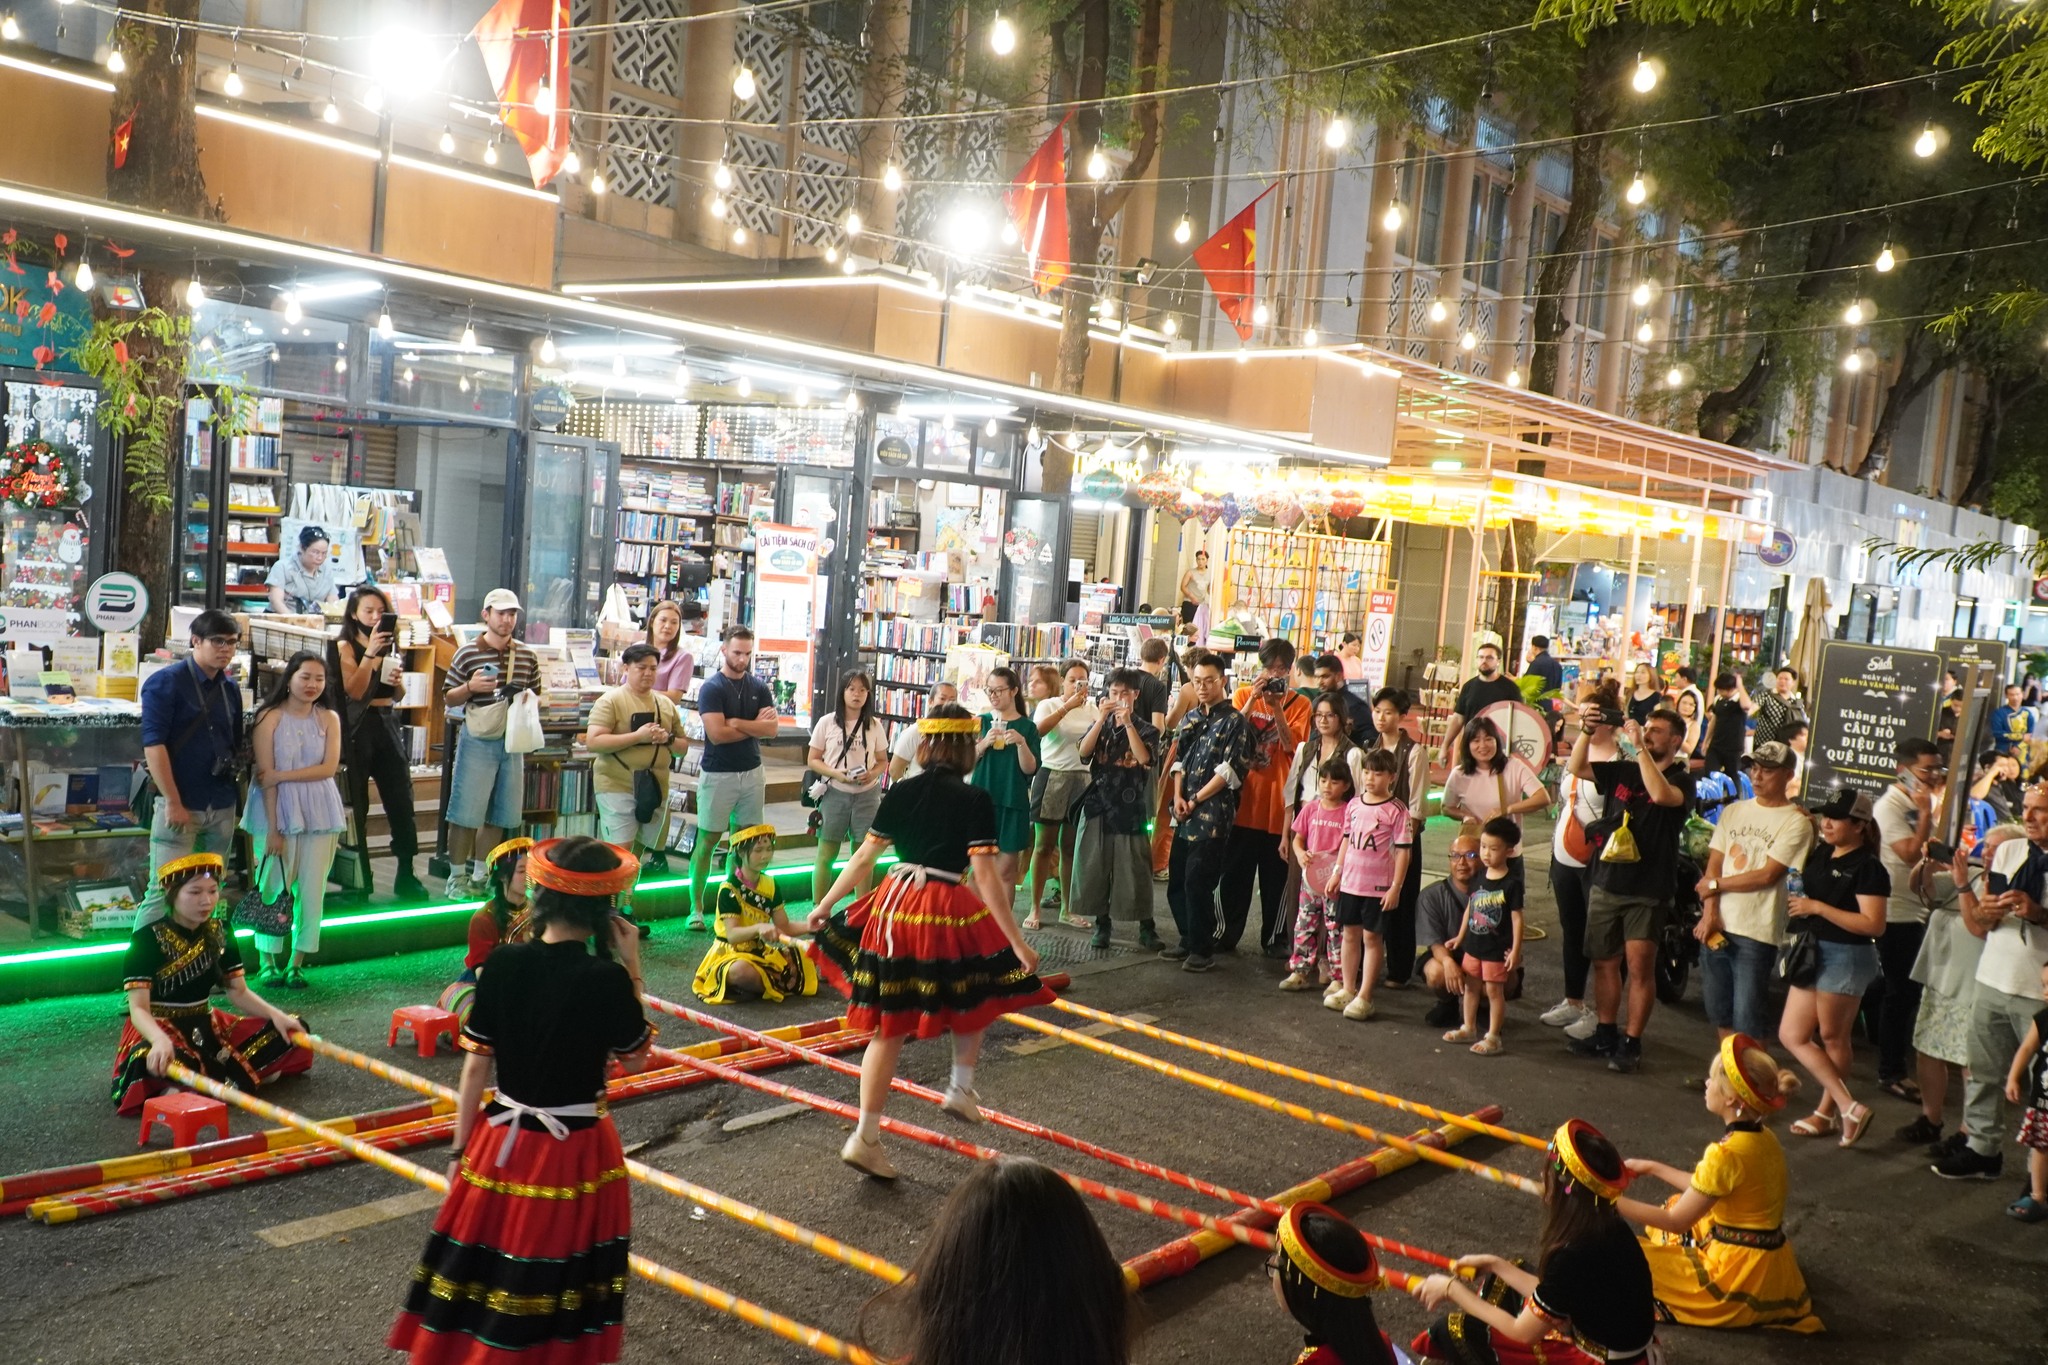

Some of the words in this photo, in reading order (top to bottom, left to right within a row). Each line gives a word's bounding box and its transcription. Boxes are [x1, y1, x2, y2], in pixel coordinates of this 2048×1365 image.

[9, 619, 65, 630] PHANBOOK
[1132, 615, 1148, 625] English
[1148, 616, 1171, 625] Bookstore
[1866, 654, 1893, 672] Sách
[1839, 676, 1857, 686] SÁCH
[1859, 679, 1869, 688] VÀ
[1869, 680, 1884, 690] VĂN
[1862, 673, 1880, 683] NGÀY
[1882, 674, 1896, 685] HỘI
[1840, 708, 1877, 725] Không
[1880, 713, 1907, 727] gian
[1843, 721, 1871, 736] CÂU
[1875, 725, 1895, 739] HÒ
[1841, 736, 1875, 752] ĐIỆU
[1879, 740, 1897, 754] LÝ
[1826, 748, 1854, 763] QUÊ
[1858, 753, 1898, 769] HƯƠN
[1312, 818, 1327, 827] BABY
[1327, 819, 1342, 829] GIRL
